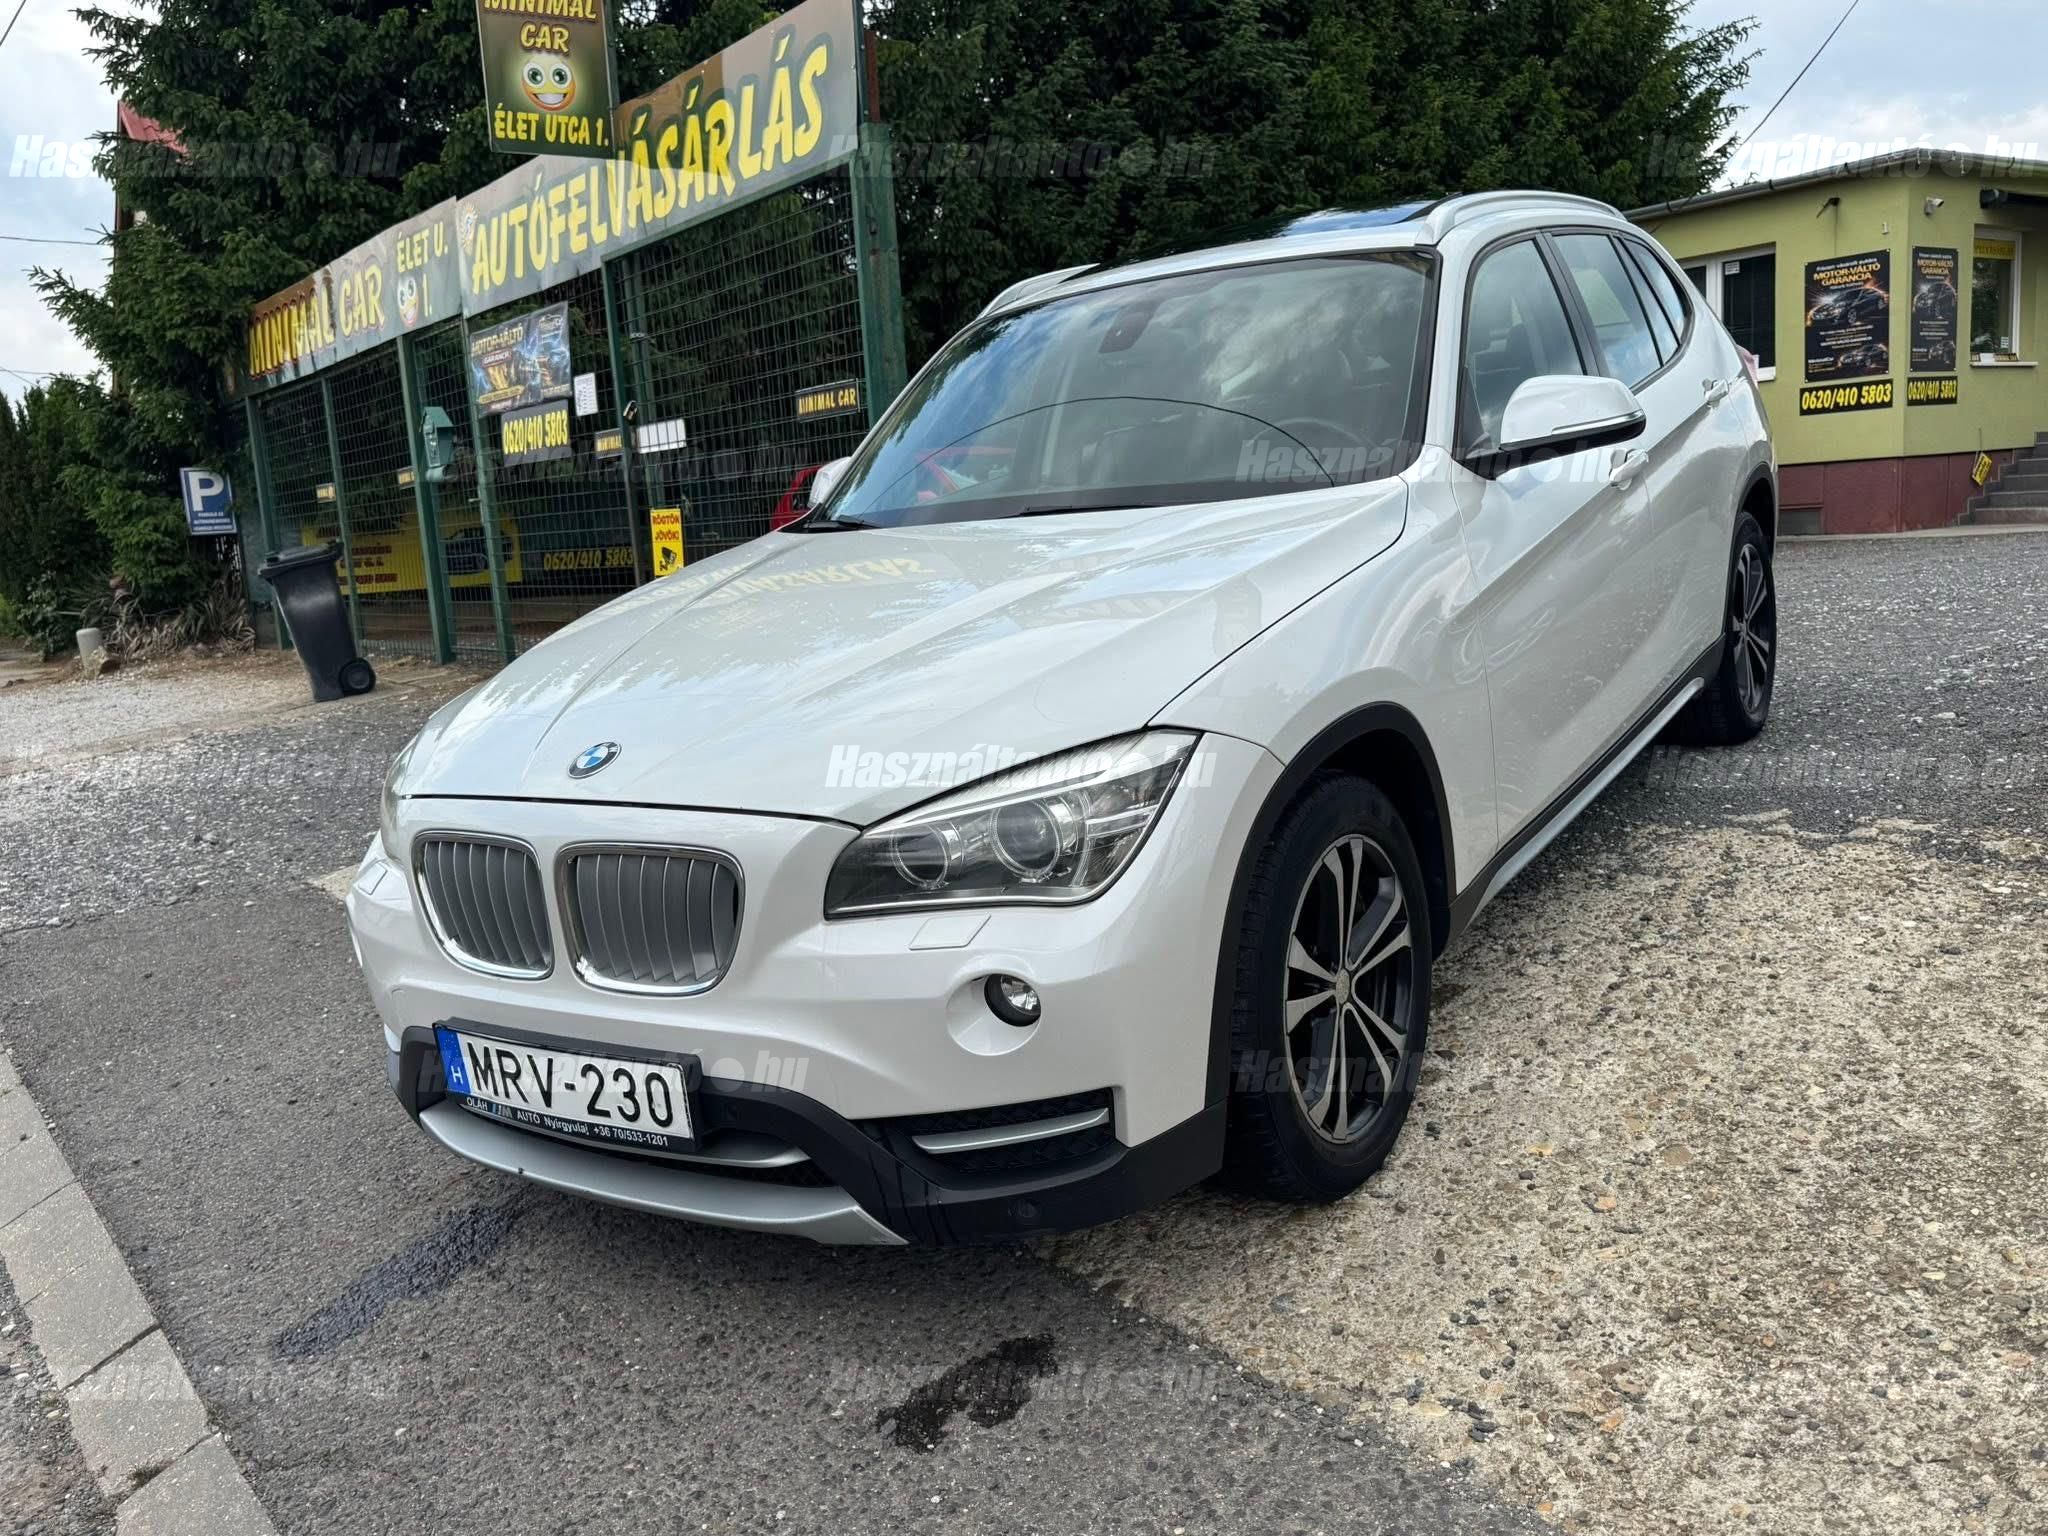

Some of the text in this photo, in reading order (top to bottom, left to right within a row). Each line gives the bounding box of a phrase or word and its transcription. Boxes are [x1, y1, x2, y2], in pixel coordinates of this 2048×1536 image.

[520, 24, 569, 52] CAR
[494, 102, 540, 141] ÉLET
[545, 113, 591, 145] UTCA
[471, 34, 828, 296] AUTÓFELVÁSÁRLÁS
[396, 231, 430, 273] ÉLET
[250, 263, 385, 376] MINIMAL CAR
[838, 387, 857, 408] CAR
[1802, 383, 1892, 410] 0620/410 5803
[1908, 379, 1957, 402] 0620/410 5803
[503, 409, 569, 456] 0620/410 5803
[188, 471, 225, 511] P
[543, 545, 634, 571] 0620/410 5803
[450, 1065, 464, 1086] H
[467, 1042, 674, 1128] MRV-230
[517, 1110, 541, 1124] AUTÓ
[594, 1126, 611, 1137] +36
[612, 1128, 669, 1146] 70/533-1201
